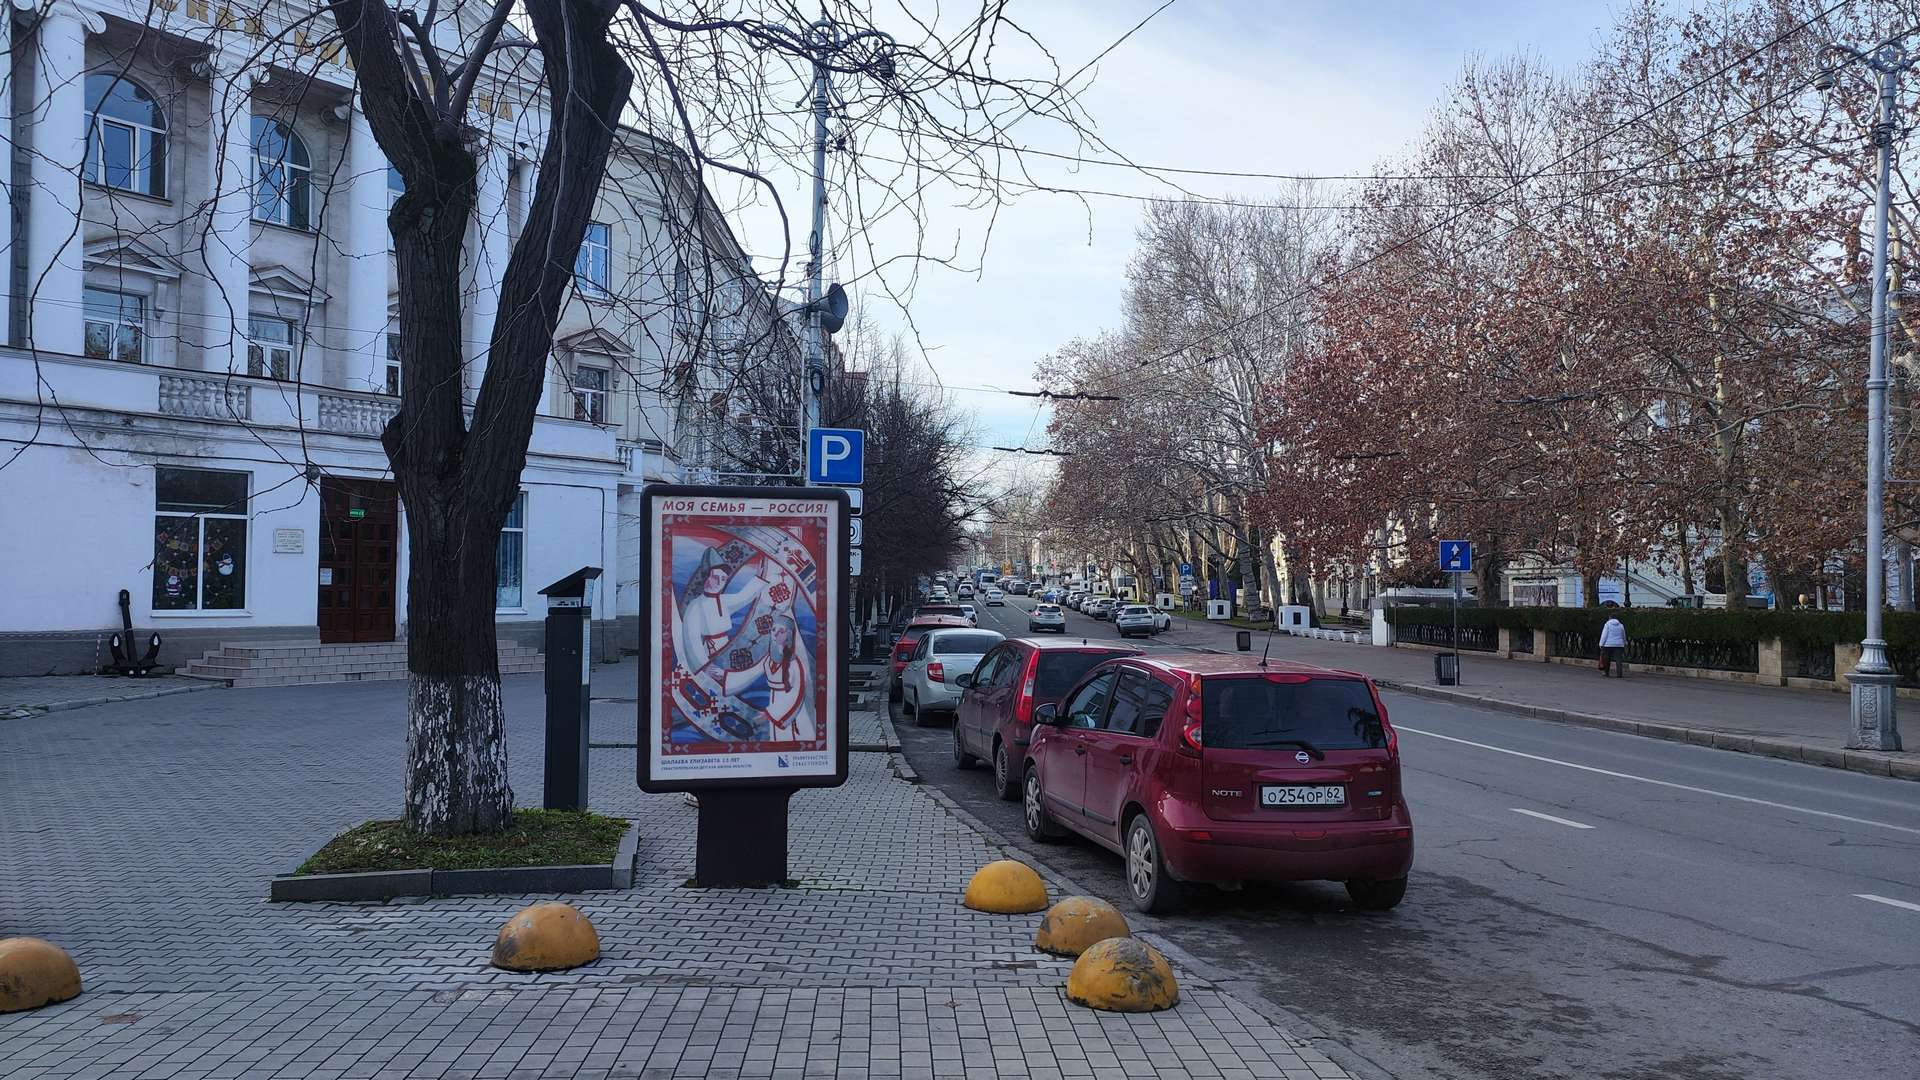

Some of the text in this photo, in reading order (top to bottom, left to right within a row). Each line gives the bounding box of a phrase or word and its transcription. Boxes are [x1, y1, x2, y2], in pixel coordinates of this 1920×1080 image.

[821, 435, 851, 477] P
[662, 500, 695, 511] МОЯ
[701, 501, 746, 513] СЕМЬЯ
[768, 503, 829, 514] РОССИЯ!
[1212, 789, 1243, 797] NOTE
